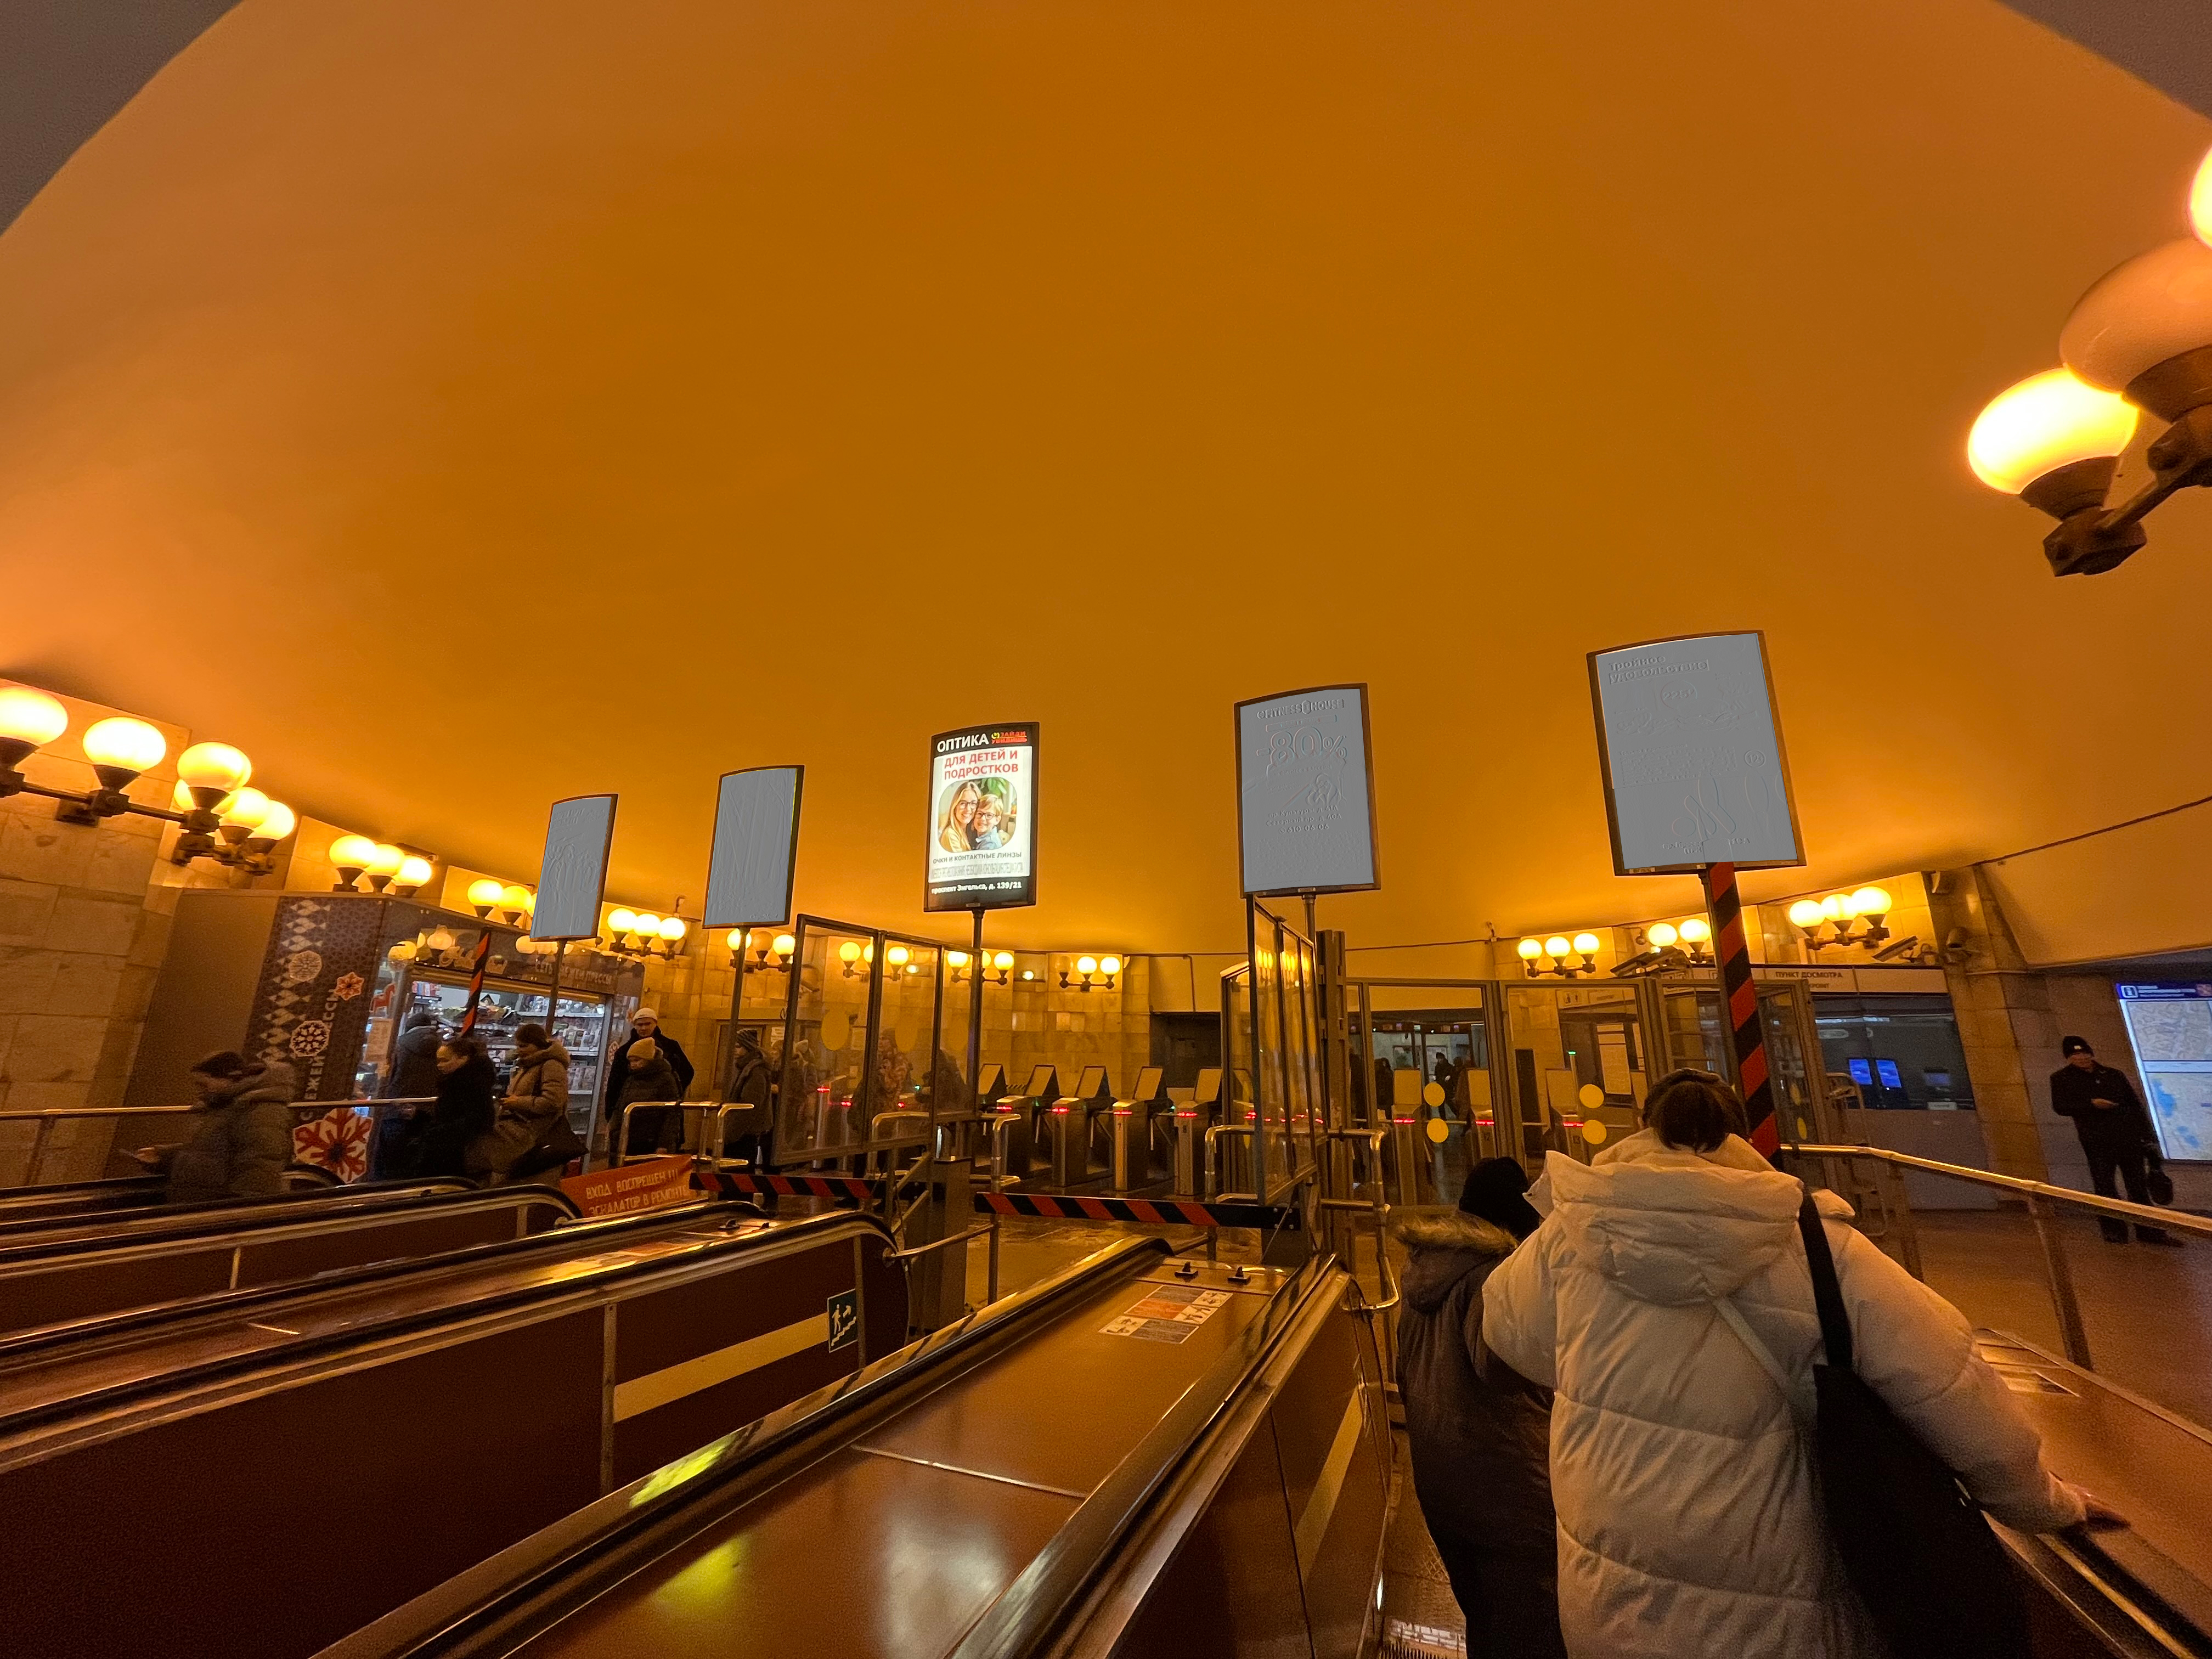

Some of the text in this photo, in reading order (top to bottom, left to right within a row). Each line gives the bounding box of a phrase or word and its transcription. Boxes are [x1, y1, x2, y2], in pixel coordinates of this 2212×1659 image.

[937, 733, 989, 753] ОПТИКА
[944, 749, 1018, 769] ДЛЯ ДЕТЕЙ И
[944, 764, 1019, 780] ПОДРОСТКОВ
[931, 886, 957, 894] проспект
[997, 882, 1022, 890] 139/21
[585, 1182, 612, 1200] ВХОД
[588, 1195, 641, 1216] ЭСКАЛАТОР
[643, 1194, 649, 1205] В
